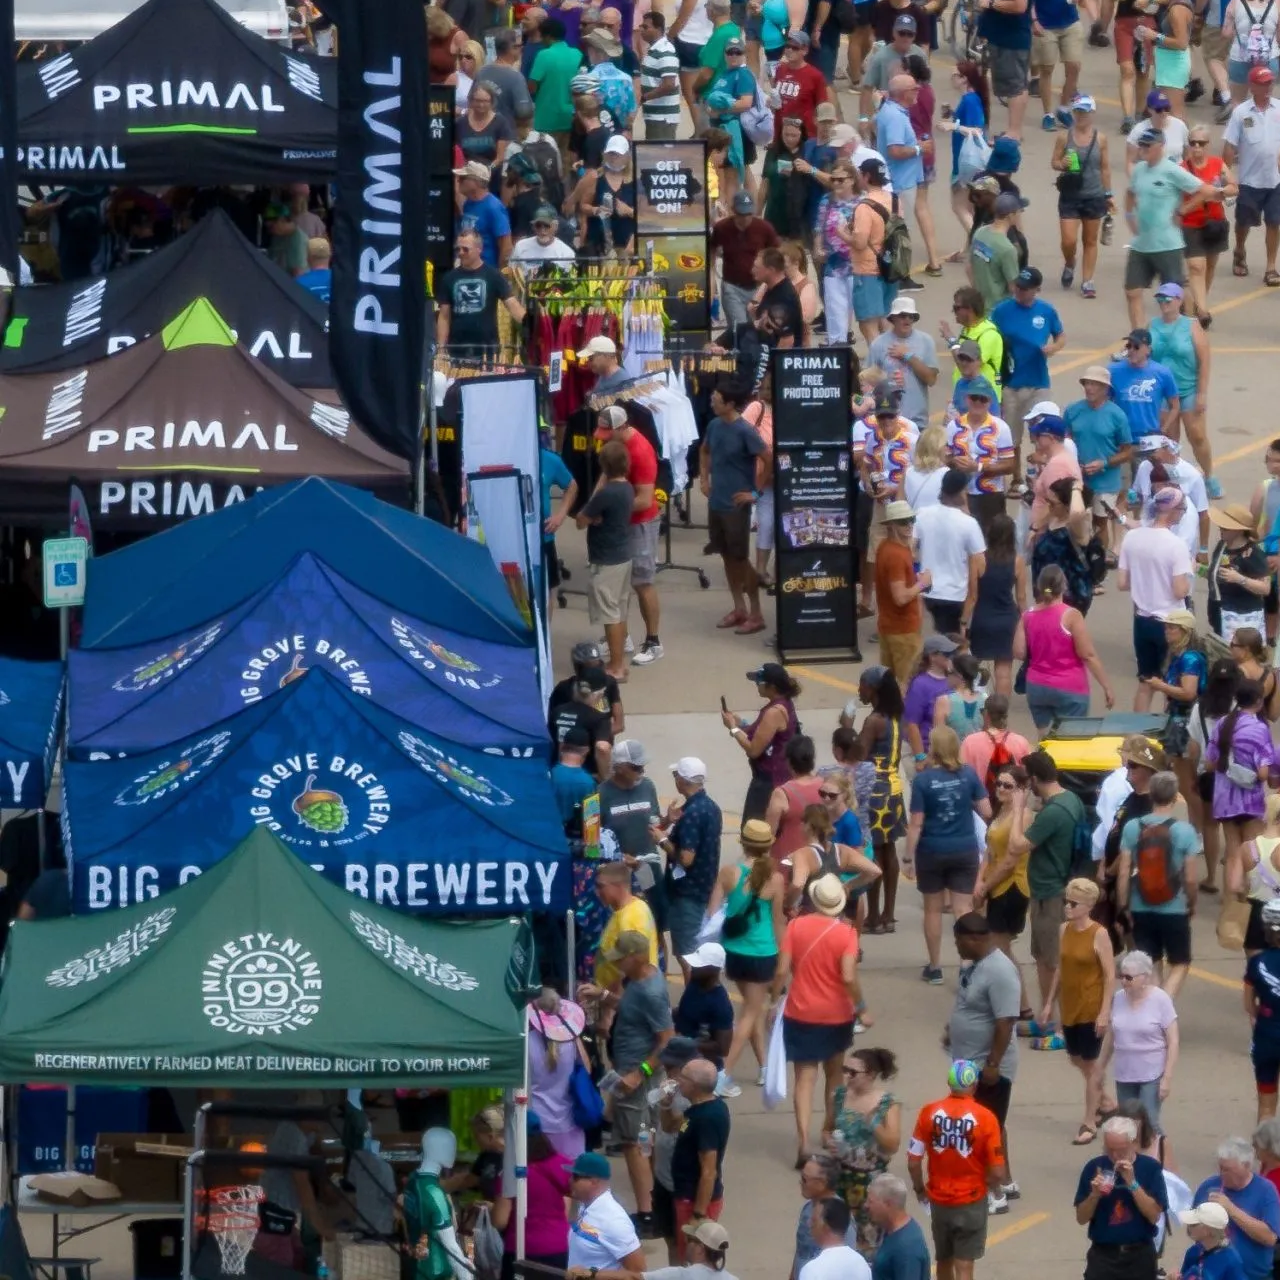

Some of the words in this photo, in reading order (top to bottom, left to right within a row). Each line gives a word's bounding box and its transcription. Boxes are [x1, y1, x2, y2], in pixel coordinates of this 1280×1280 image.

[93, 80, 285, 113] PRIMAL
[656, 161, 681, 171] GET
[650, 174, 687, 186] YOUR
[354, 56, 402, 336] PRIMAL
[650, 189, 688, 200] IOWA
[656, 203, 682, 214] ON!
[784, 357, 840, 369] PRIMAL
[784, 388, 811, 398] PHOTO
[813, 387, 841, 398] BOOTH
[802, 375, 824, 386] FREE
[88, 420, 299, 452] PRIMAL
[100, 481, 265, 516] PRIMA
[242, 634, 306, 681] GROVE
[315, 640, 372, 696] BREWE
[251, 752, 321, 799] GROVE
[330, 756, 391, 834] BREWERY
[88, 865, 160, 909] BIG
[345, 860, 559, 905] BREWERY
[237, 980, 289, 1007] 99
[203, 1001, 321, 1036] COUNTIES
[34, 1053, 152, 1070] REGENERATIVELY
[154, 1056, 212, 1071] FARMED
[215, 1056, 253, 1071] MEAT
[256, 1056, 332, 1072] DELIVERED
[334, 1057, 376, 1072] RIGHT
[380, 1058, 399, 1072] TO
[403, 1058, 444, 1073] YOUR
[447, 1057, 491, 1072] HOME
